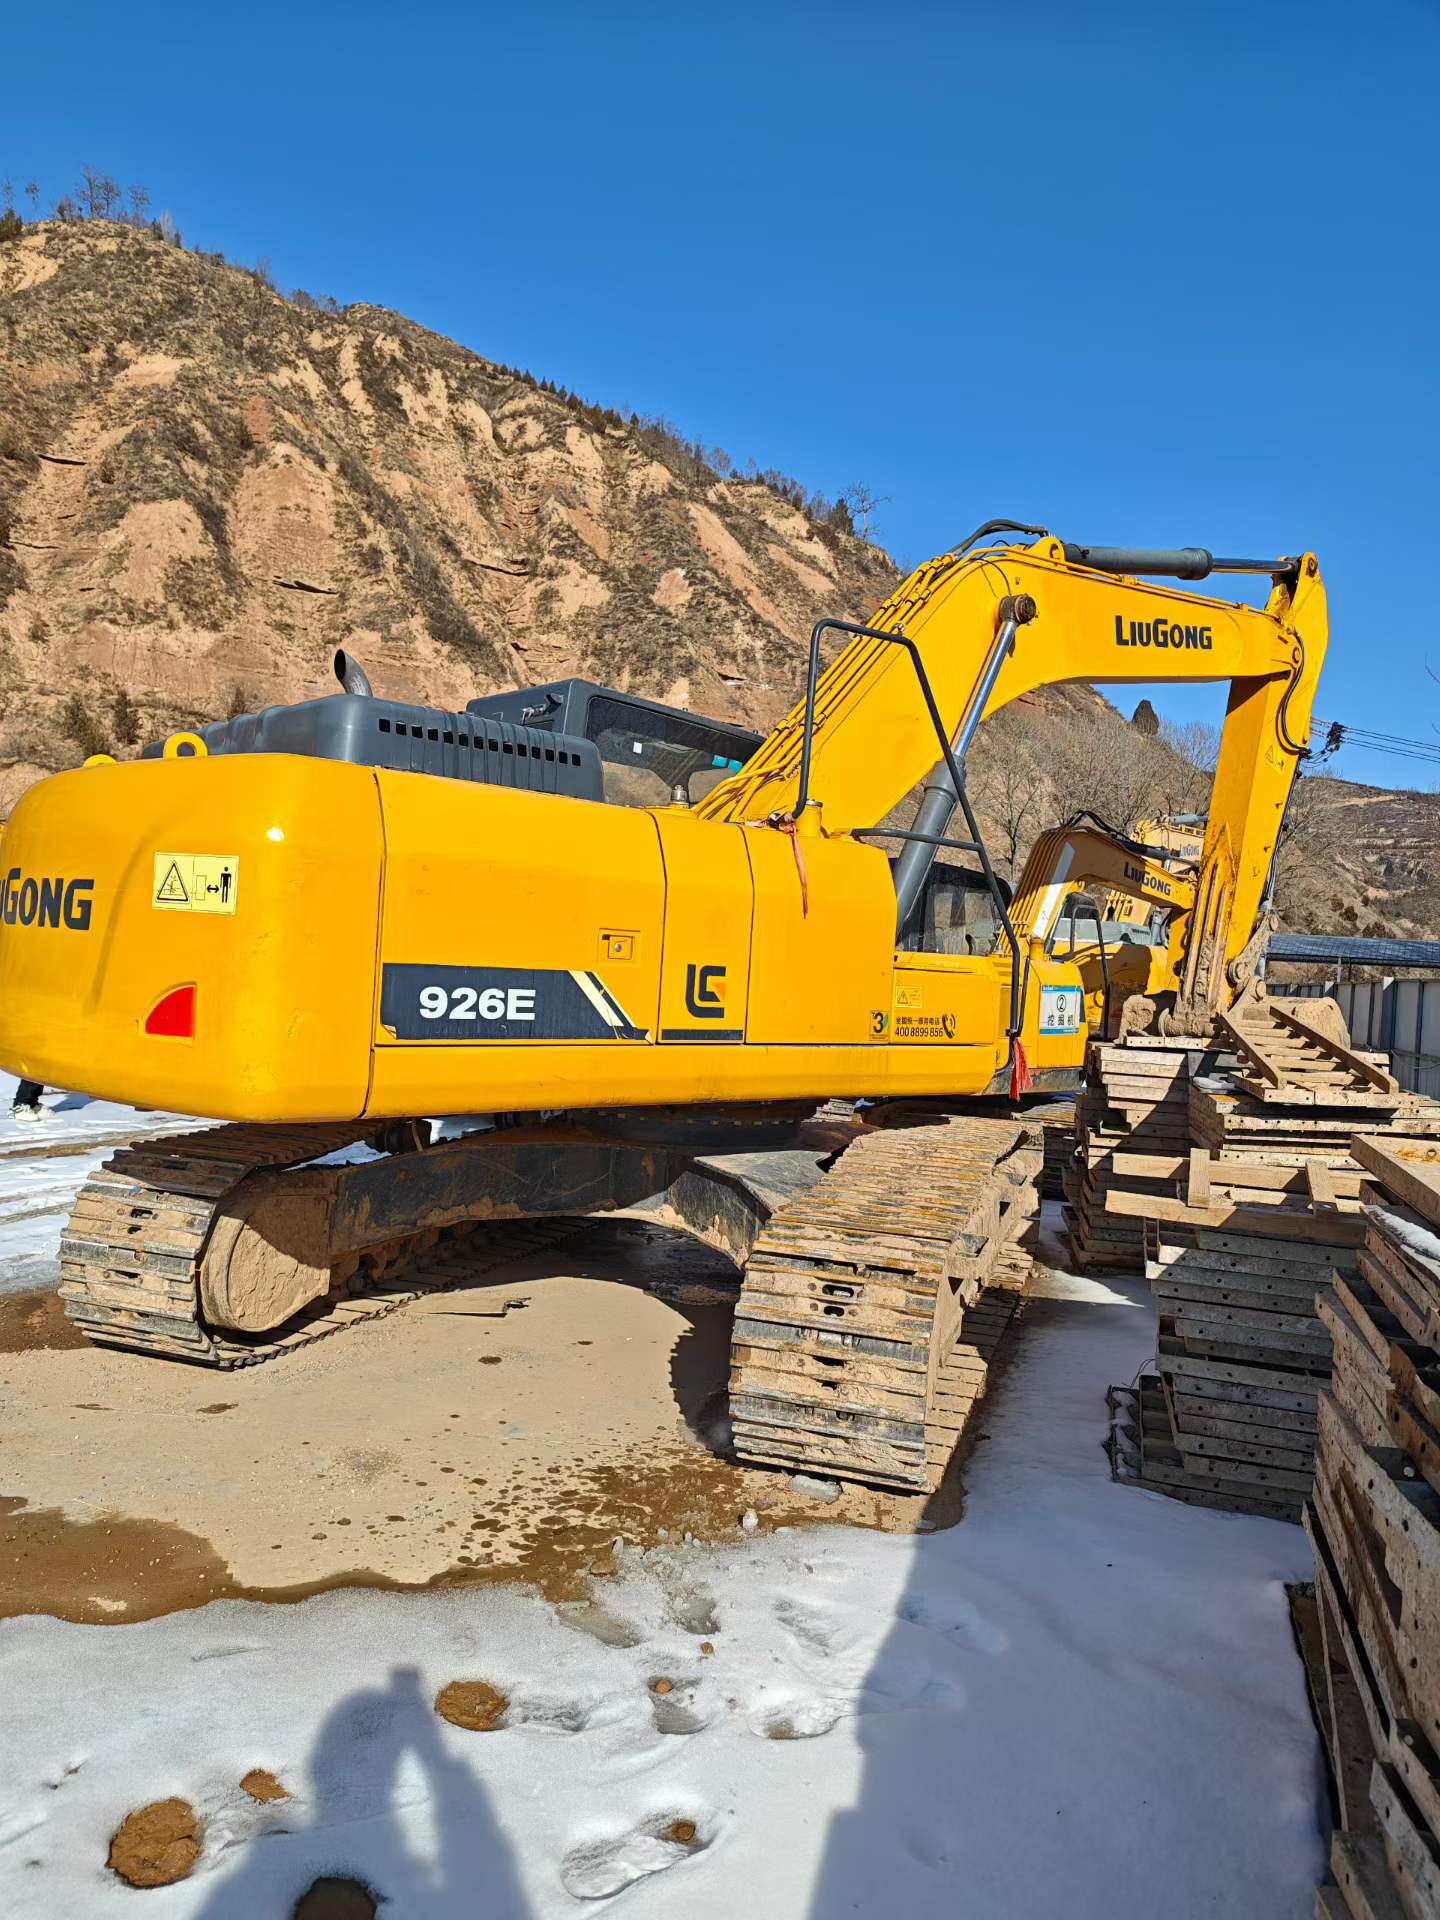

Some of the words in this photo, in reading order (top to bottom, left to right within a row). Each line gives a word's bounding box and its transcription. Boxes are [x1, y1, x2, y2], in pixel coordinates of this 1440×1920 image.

[1115, 615, 1212, 650] LIUGONG
[1123, 861, 1171, 896] LIUGONG
[419, 986, 536, 1021] 926E
[873, 1012, 884, 1034] 3
[895, 1026, 910, 1037] 400
